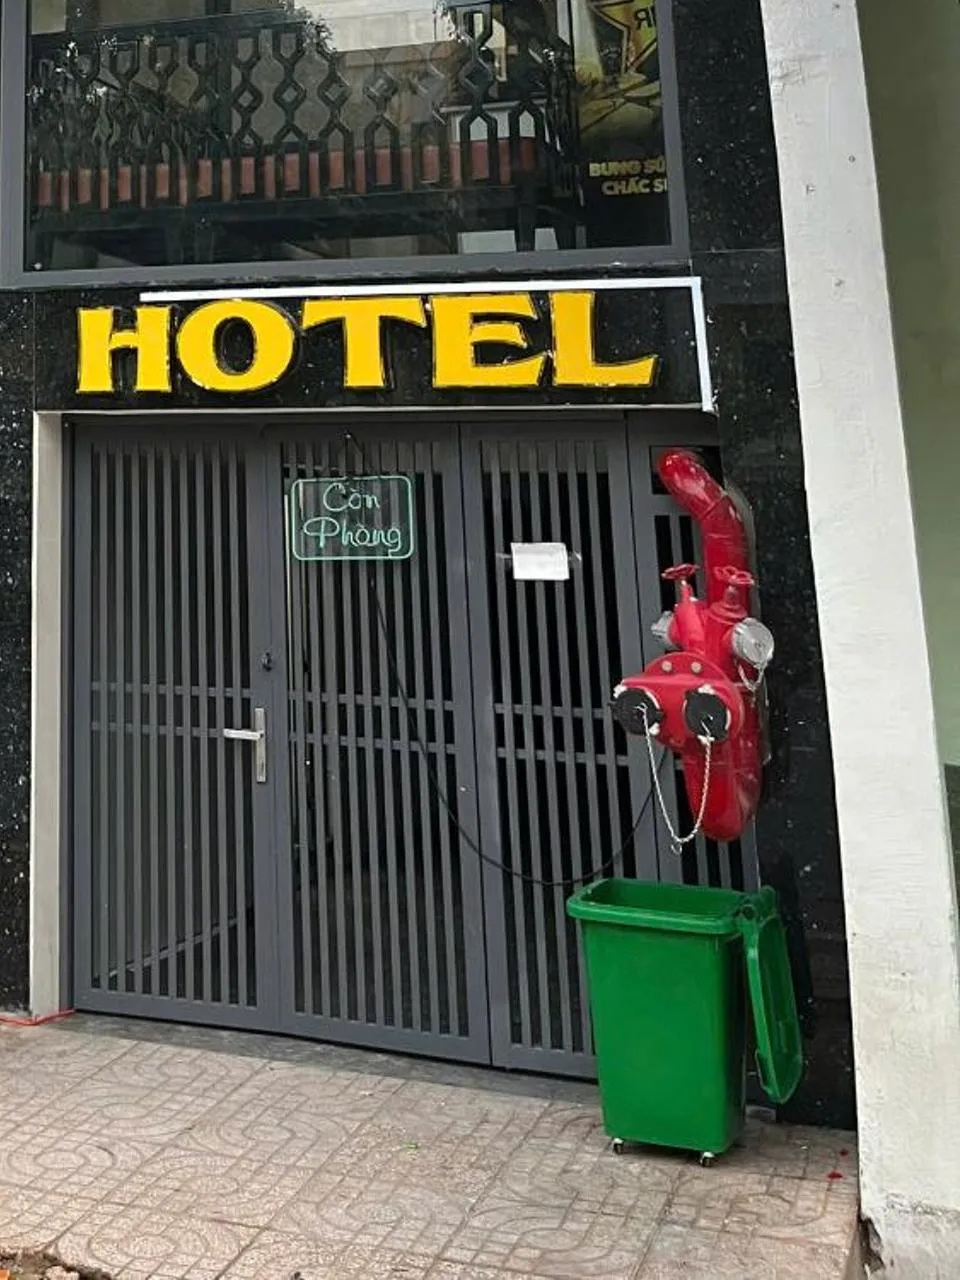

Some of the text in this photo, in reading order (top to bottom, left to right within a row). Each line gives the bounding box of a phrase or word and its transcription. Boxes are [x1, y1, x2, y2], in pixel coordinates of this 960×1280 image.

[77, 291, 657, 393] HOTEL
[323, 481, 381, 513] Còn
[303, 516, 401, 554] Phòng
